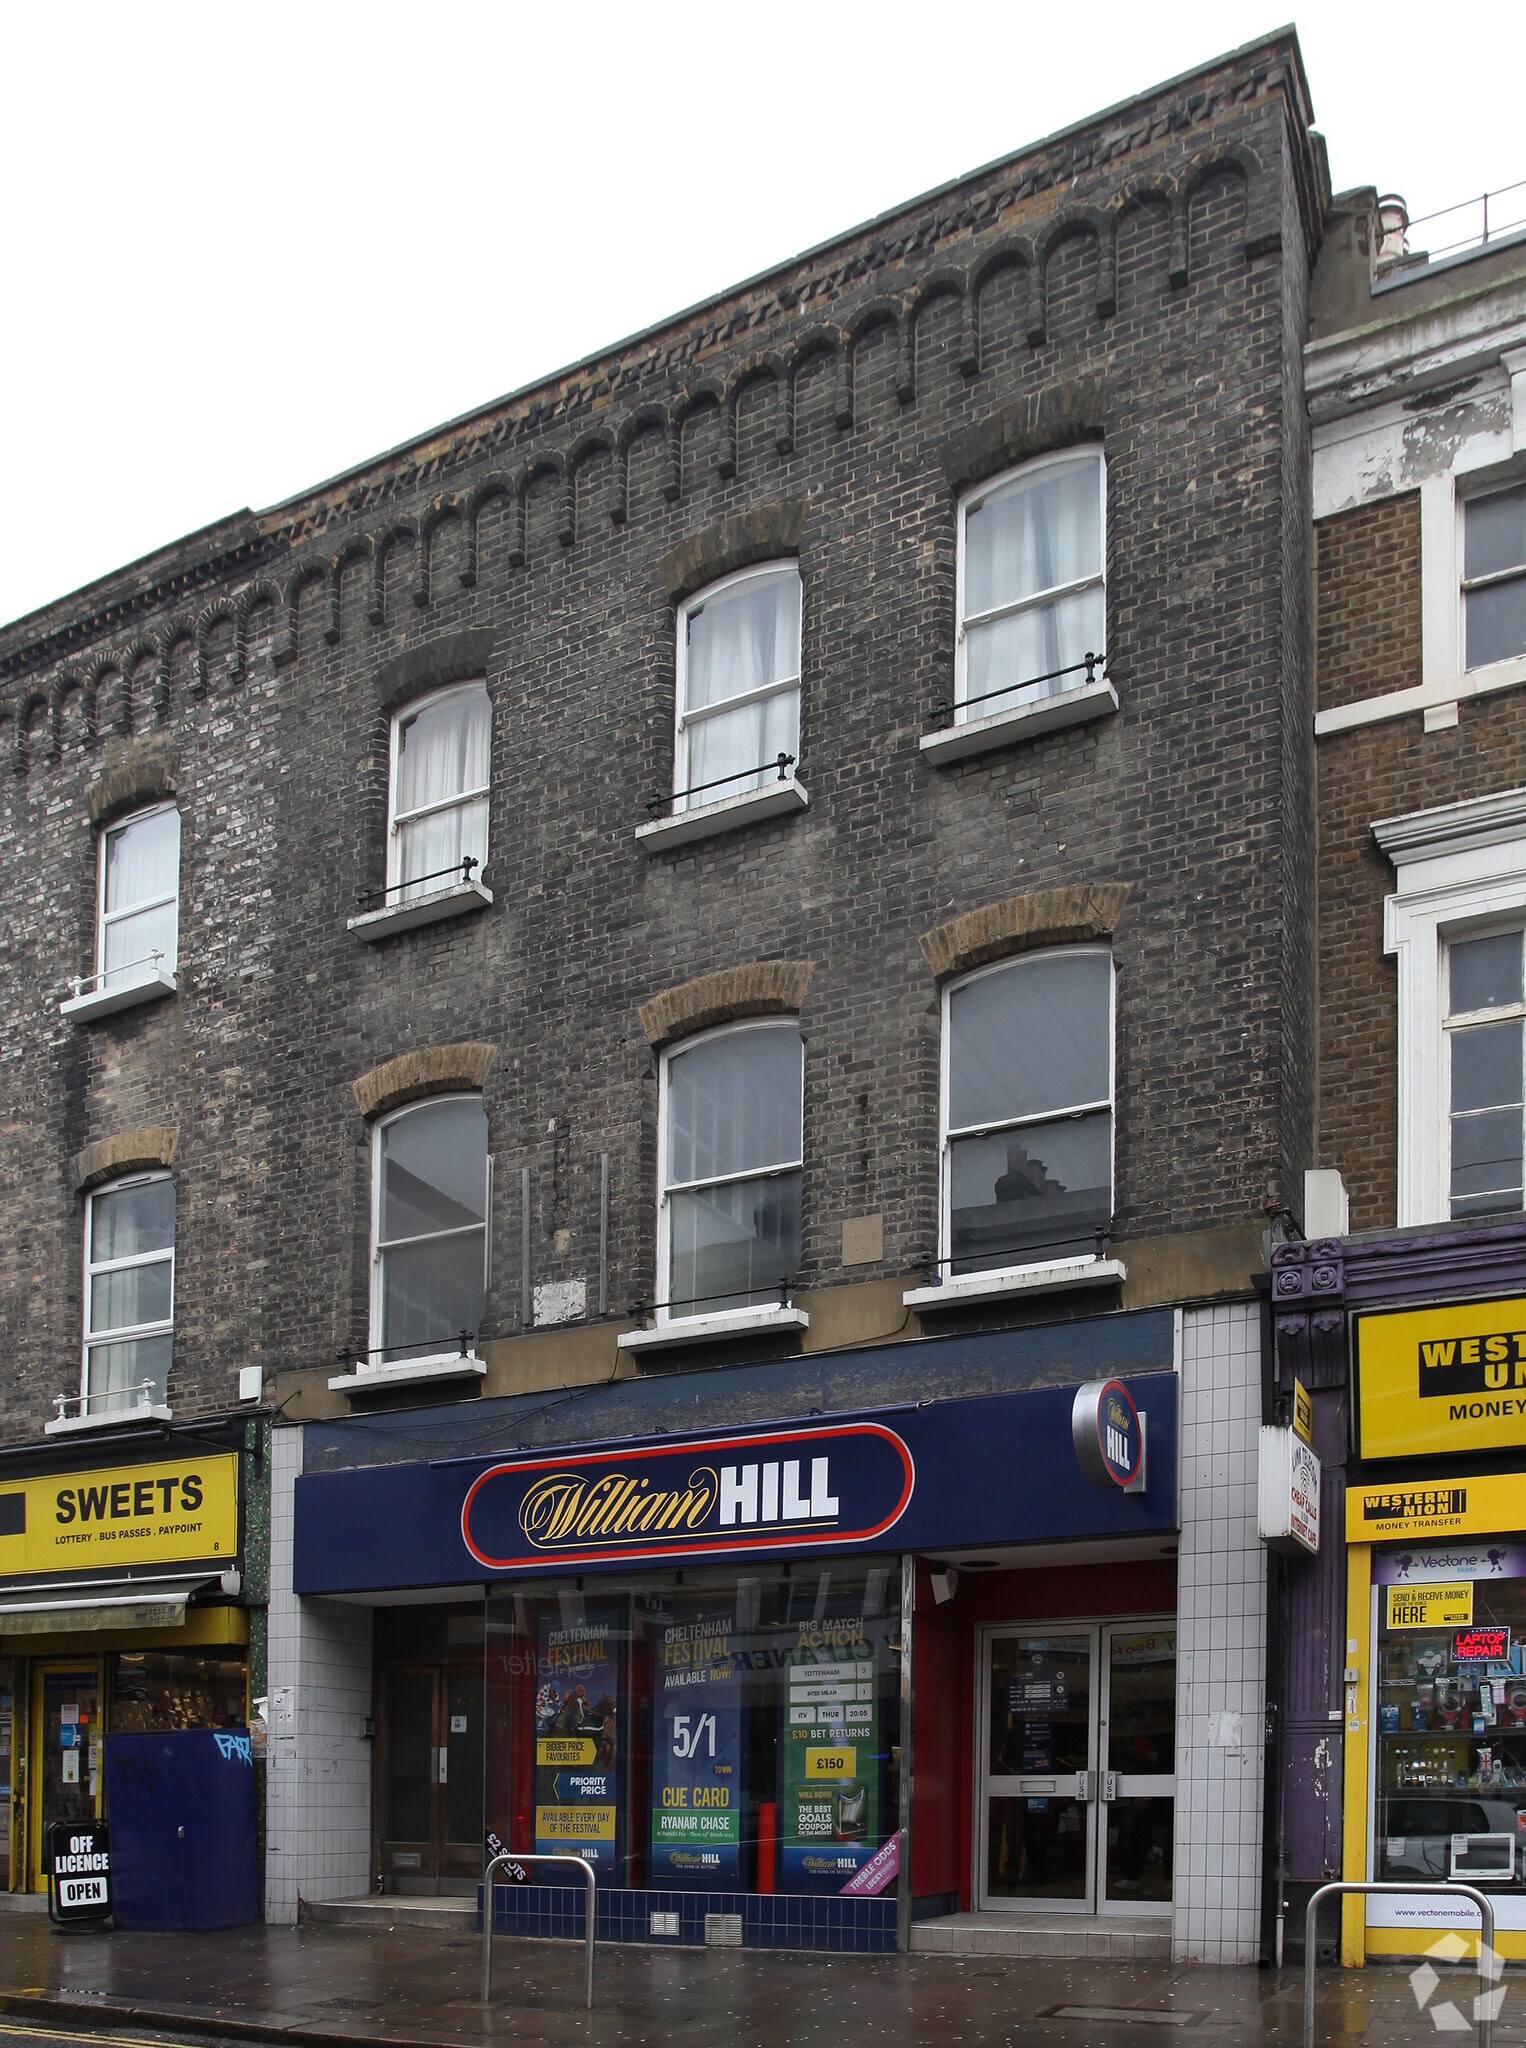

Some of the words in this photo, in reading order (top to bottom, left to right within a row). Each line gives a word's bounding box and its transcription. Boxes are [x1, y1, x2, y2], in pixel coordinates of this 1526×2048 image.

[1106, 1425, 1130, 1470] HILL
[55, 1474, 203, 1525] SWEETS
[519, 1467, 718, 1541] William
[720, 1457, 839, 1525] HILL
[1365, 1491, 1449, 1508] WESTERN
[1391, 1503, 1449, 1517] NION
[1376, 1521, 1410, 1531] MONEY
[1413, 1517, 1461, 1528] TRANSFER
[55, 1533, 93, 1545] LOTTERY
[100, 1530, 117, 1541] BUS
[119, 1527, 151, 1539] PASSES
[158, 1522, 203, 1536] PAYPOINT
[213, 1542, 220, 1551] 8
[1421, 1554, 1478, 1568] Vectone
[1393, 1593, 1410, 1602] SEND
[1418, 1591, 1444, 1601] RECEIVE
[1445, 1590, 1469, 1600] MONEY
[1393, 1606, 1427, 1624] HERE
[664, 1618, 732, 1644] CHELTENHAM
[799, 1620, 819, 1632] BIG
[822, 1618, 864, 1630] MATCH
[548, 1624, 609, 1647] CHELTENHAM
[797, 1629, 864, 1648] ACTION
[1456, 1631, 1505, 1646] LAPTOP
[547, 1639, 608, 1667] FESTIVAL
[664, 1634, 731, 1666] FESTIVAL
[1457, 1645, 1503, 1657] REPAIR
[665, 1670, 706, 1688] AVAILABLE
[710, 1666, 731, 1681] NOW!
[804, 1669, 839, 1677] TOTTENHAM
[850, 1709, 868, 1717] 20:05
[673, 1713, 716, 1758] 5/1
[792, 1730, 808, 1739] £10
[811, 1729, 826, 1739] BET
[830, 1728, 870, 1739] RETURNS
[546, 1741, 566, 1752] BIGGER
[568, 1741, 584, 1752] PRICE
[546, 1752, 580, 1762] FAVOURITES
[816, 1758, 844, 1770] £150
[715, 1766, 721, 1774] TO
[722, 1766, 732, 1774] WIN
[570, 1776, 607, 1786] PRIORITY
[580, 1786, 607, 1795] PRICE
[662, 1787, 688, 1808] CUE
[693, 1787, 730, 1808] CARD
[799, 1805, 812, 1813] THE
[814, 1805, 832, 1813] BEST
[542, 1812, 574, 1822] AVAILABLE
[576, 1813, 596, 1822] EVERY
[597, 1813, 610, 1822] DAY
[661, 1816, 698, 1830] RYANAIR
[700, 1816, 730, 1830] CHASE
[798, 1814, 832, 1823] GOALS
[550, 1824, 558, 1832] OF
[559, 1824, 571, 1832] THE
[572, 1824, 601, 1834] FESTIVAL
[798, 1823, 832, 1832] COUPON
[70, 1836, 93, 1854] OFF
[487, 1833, 501, 1850] £2
[499, 1847, 526, 1881] SOTS
[582, 1848, 599, 1858] HILL
[702, 1853, 720, 1864] HILL
[55, 1853, 110, 1874] LICENCE
[837, 1858, 857, 1869] HILL
[850, 1863, 876, 1890] TREBLE
[866, 1870, 884, 1890] LUCKY
[67, 1882, 101, 1901] OPEN
